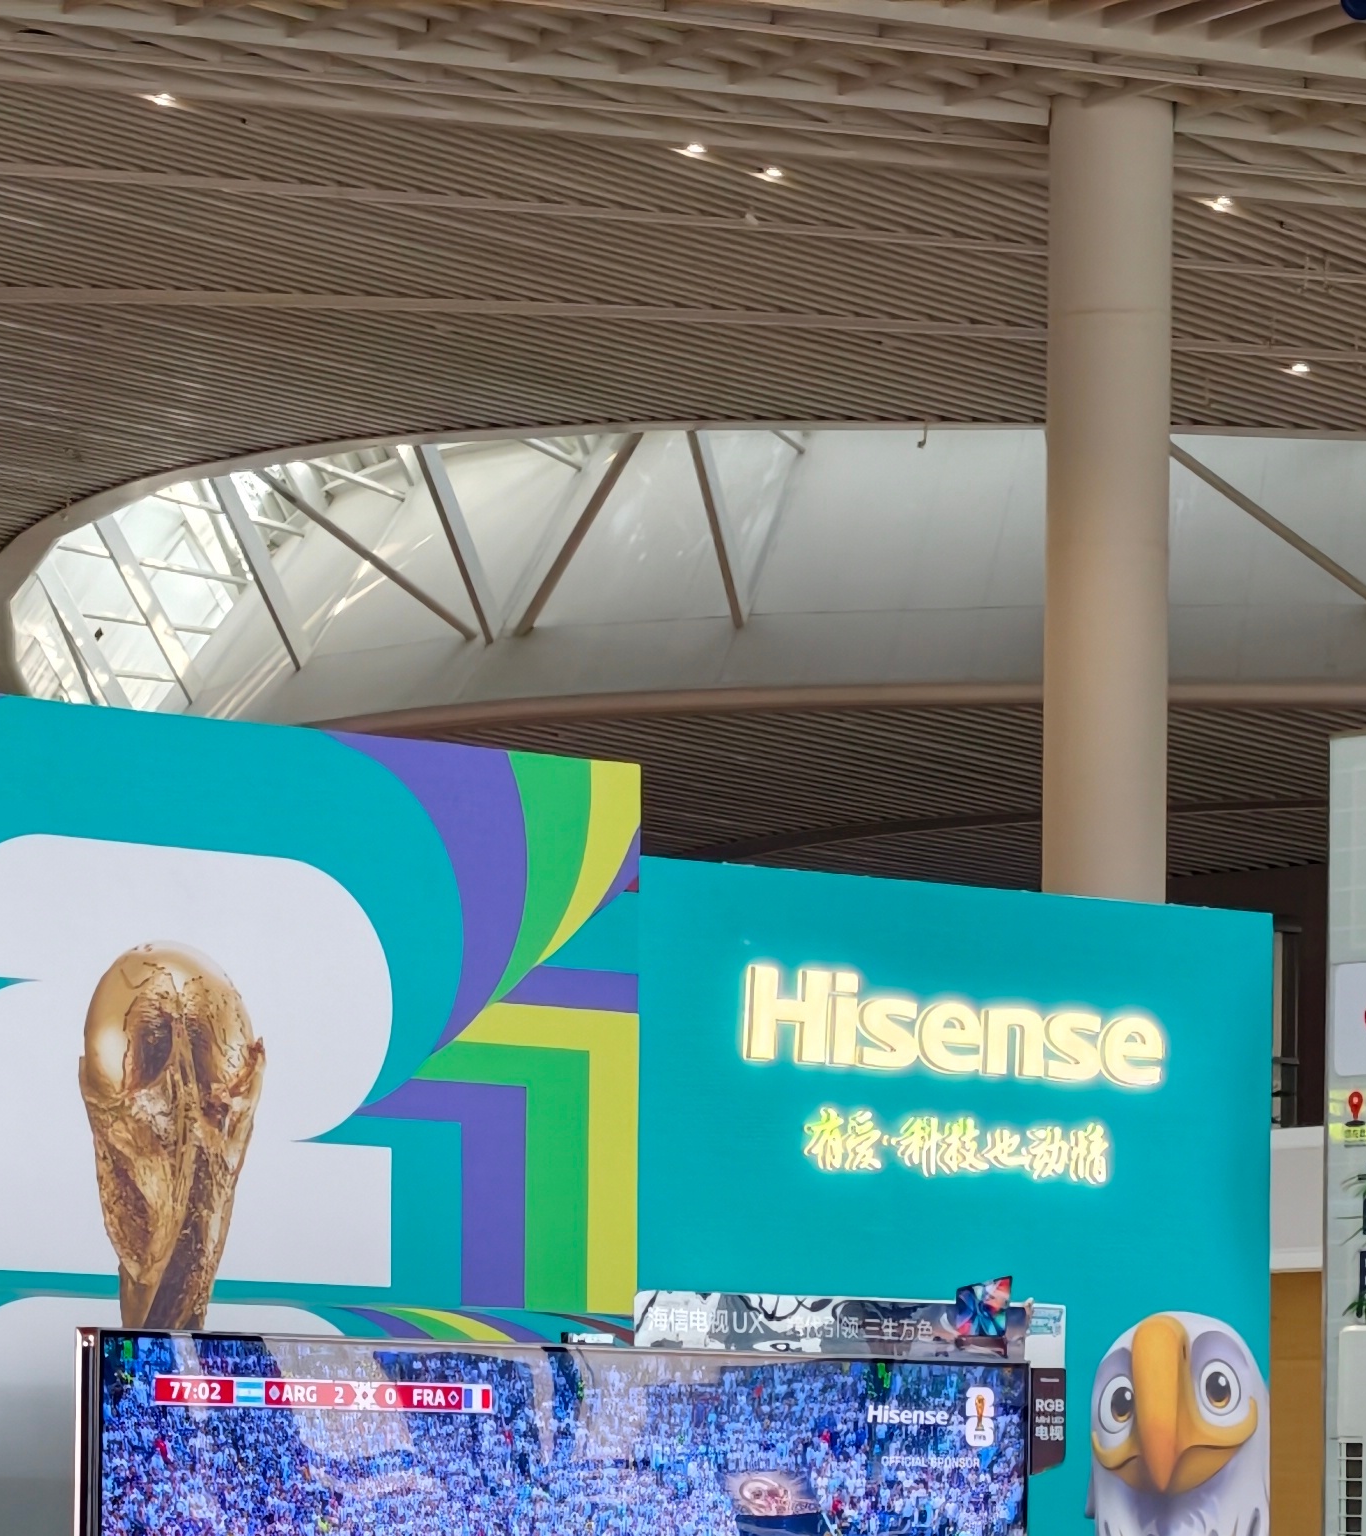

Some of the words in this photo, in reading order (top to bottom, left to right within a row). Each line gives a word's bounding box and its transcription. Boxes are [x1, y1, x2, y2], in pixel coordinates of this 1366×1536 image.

[743, 964, 1165, 1086] Hisense
[647, 1306, 730, 1333] 海信电视
[732, 1310, 768, 1335] UX
[168, 1380, 222, 1401] 77:02
[281, 1384, 318, 1403] ARG
[334, 1387, 345, 1405] 2
[384, 1388, 397, 1405] 0
[412, 1388, 447, 1407] FRA
[1035, 1398, 1065, 1413] RGB
[867, 1404, 950, 1426] Hisense
[1035, 1425, 1064, 1441] 电视
